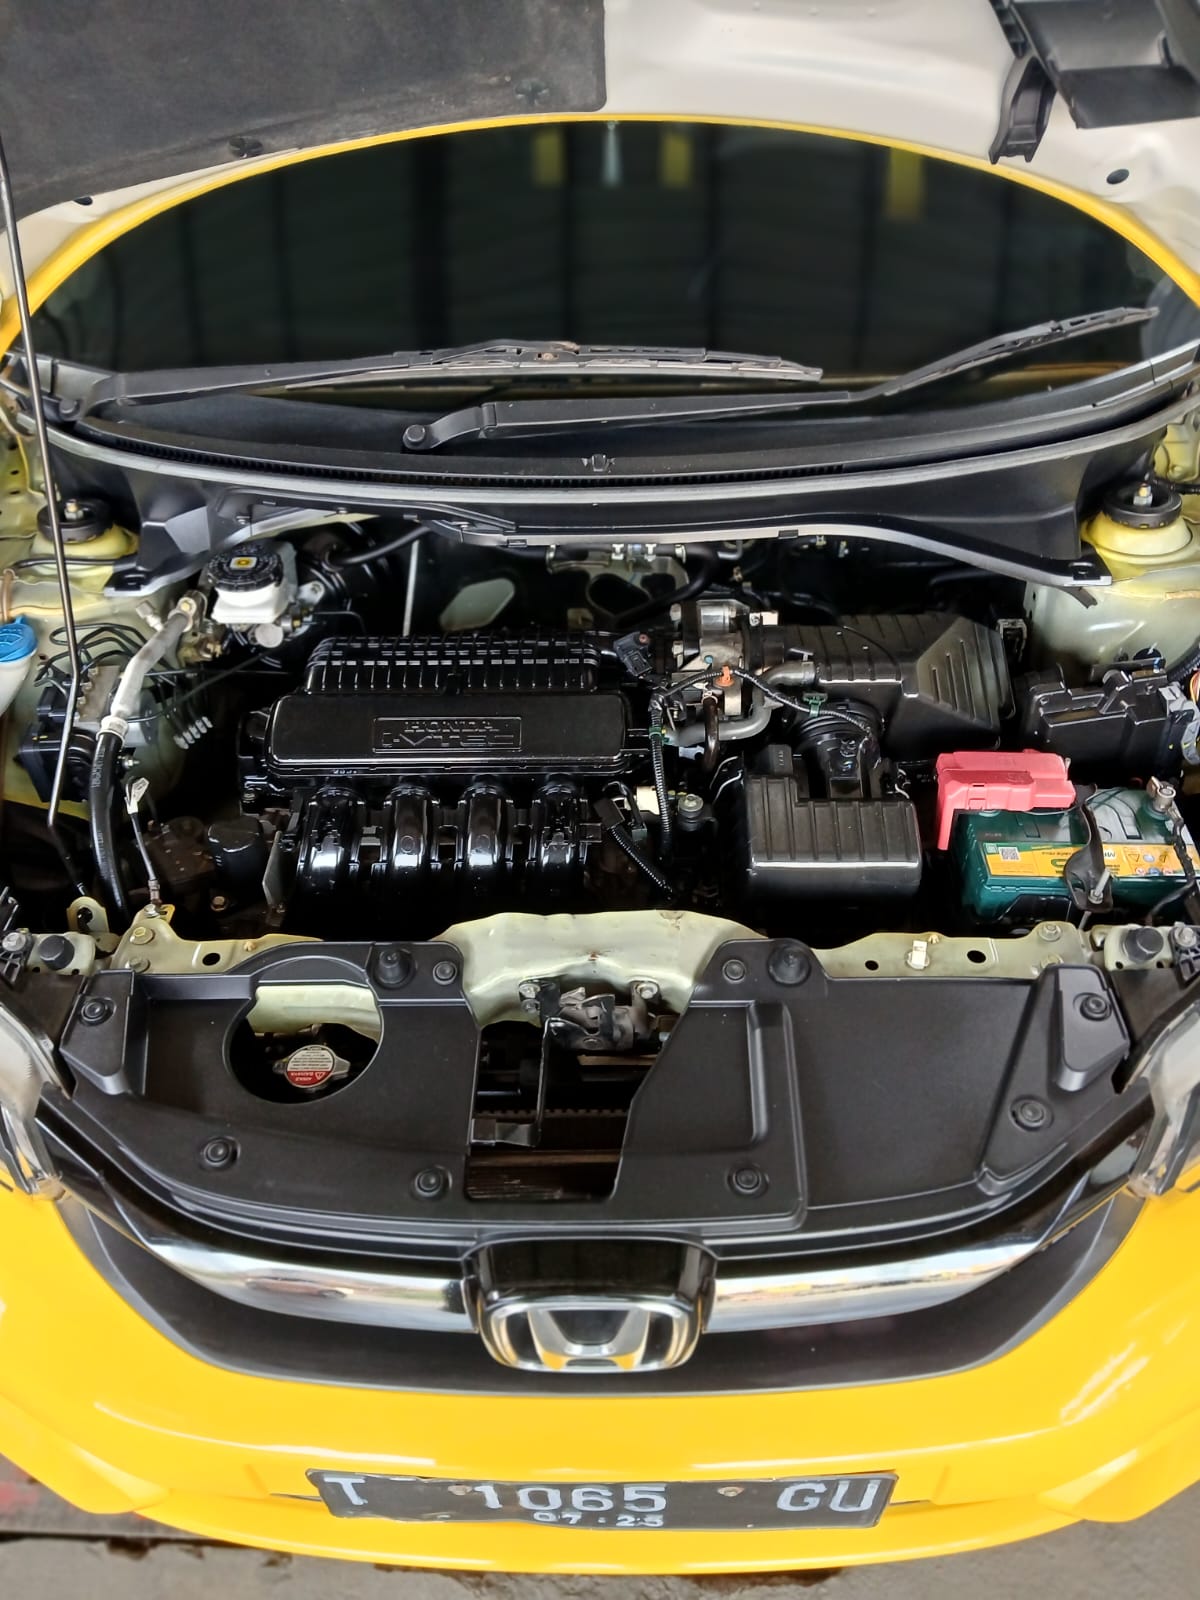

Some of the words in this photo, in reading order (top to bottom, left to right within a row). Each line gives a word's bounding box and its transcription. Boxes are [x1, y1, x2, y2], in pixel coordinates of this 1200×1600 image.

[404, 721, 500, 732] HONDA
[323, 1475, 368, 1505] T
[474, 1483, 667, 1512] 1065
[776, 1479, 882, 1512] GU
